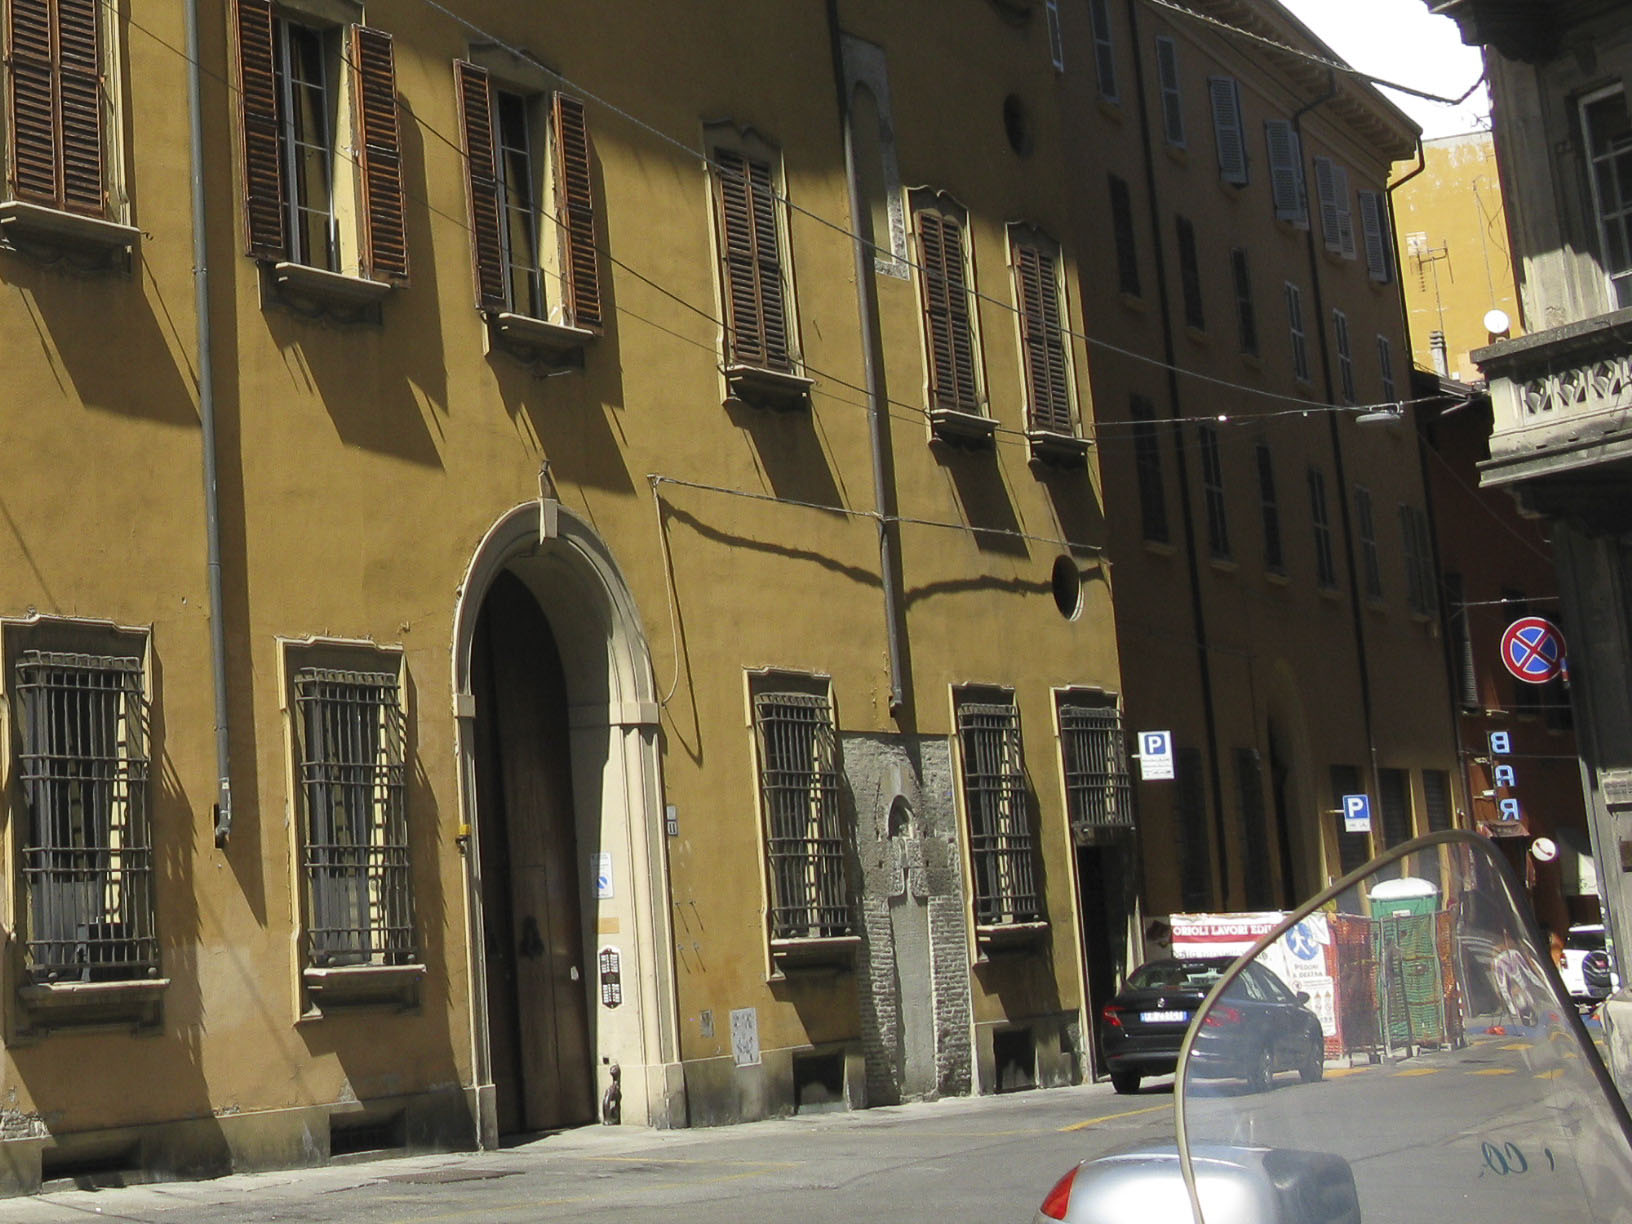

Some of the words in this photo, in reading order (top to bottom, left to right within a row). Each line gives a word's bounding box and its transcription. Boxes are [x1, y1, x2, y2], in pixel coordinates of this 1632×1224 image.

[1148, 735, 1162, 754] P
[1347, 797, 1364, 818] P
[1172, 925, 1209, 936] ORIOLI
[1210, 924, 1249, 935] LAVORI
